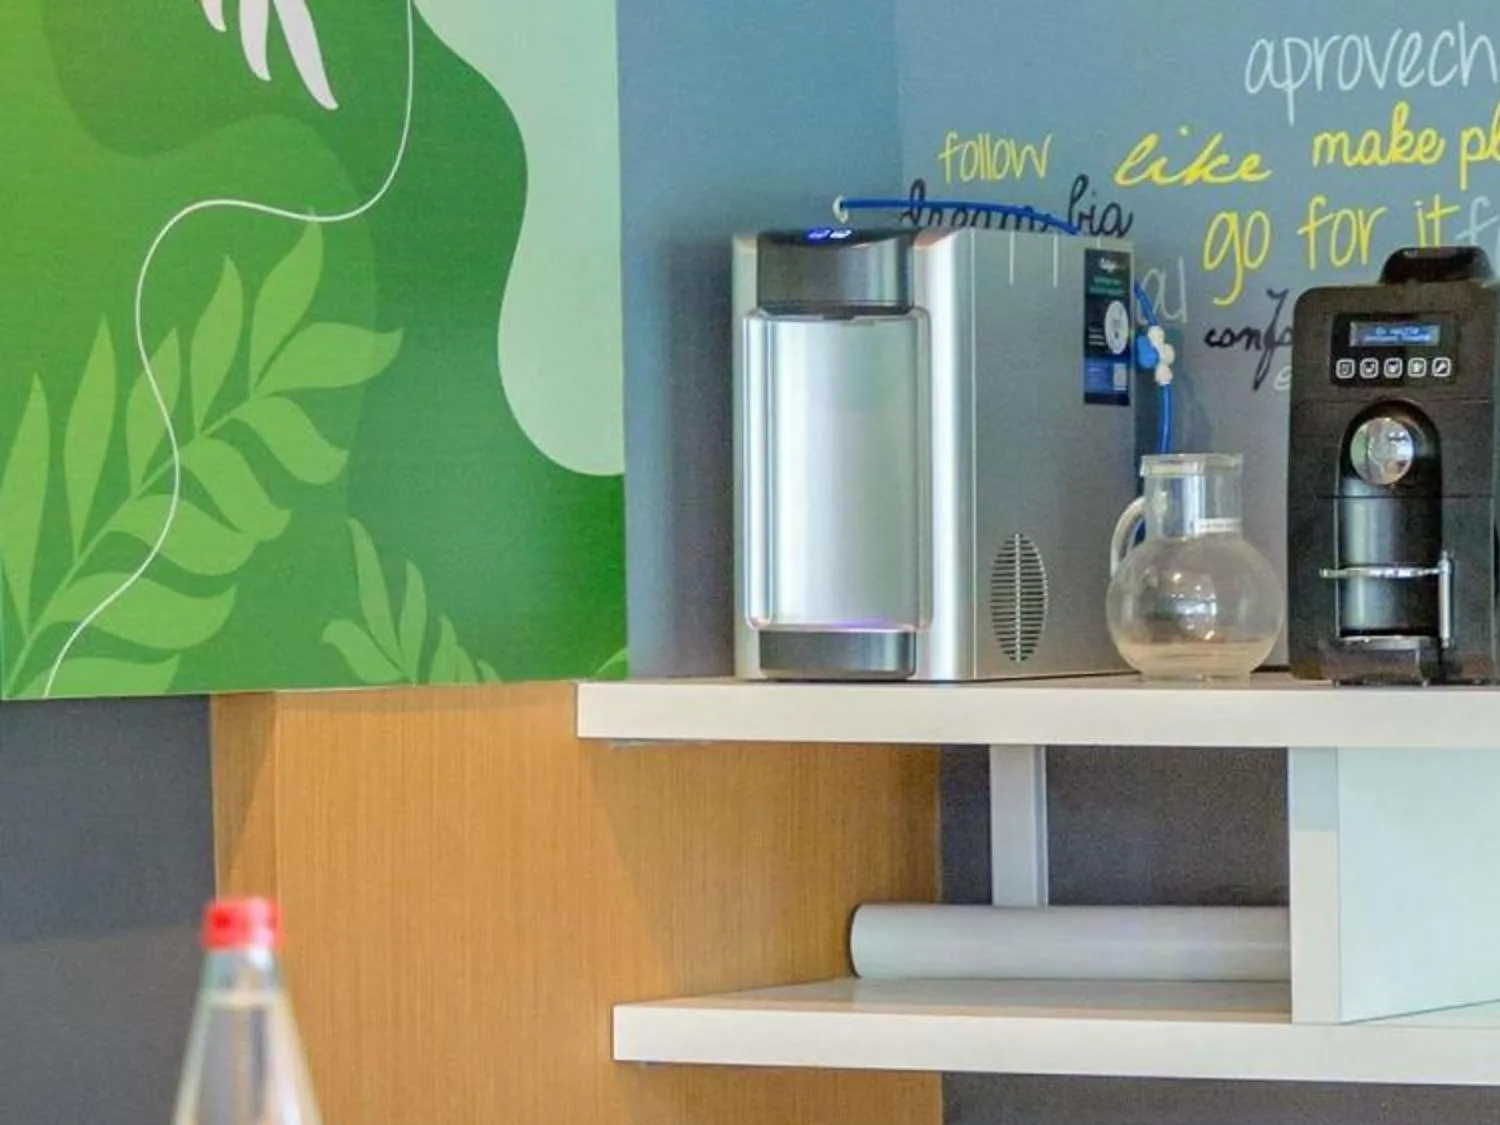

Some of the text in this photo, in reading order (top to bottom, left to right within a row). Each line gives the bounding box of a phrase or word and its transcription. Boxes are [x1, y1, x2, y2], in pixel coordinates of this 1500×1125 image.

[937, 130, 1053, 184] follow
[1113, 125, 1273, 188] like
[1312, 101, 1446, 168] make
[1204, 193, 1461, 306] go for it
